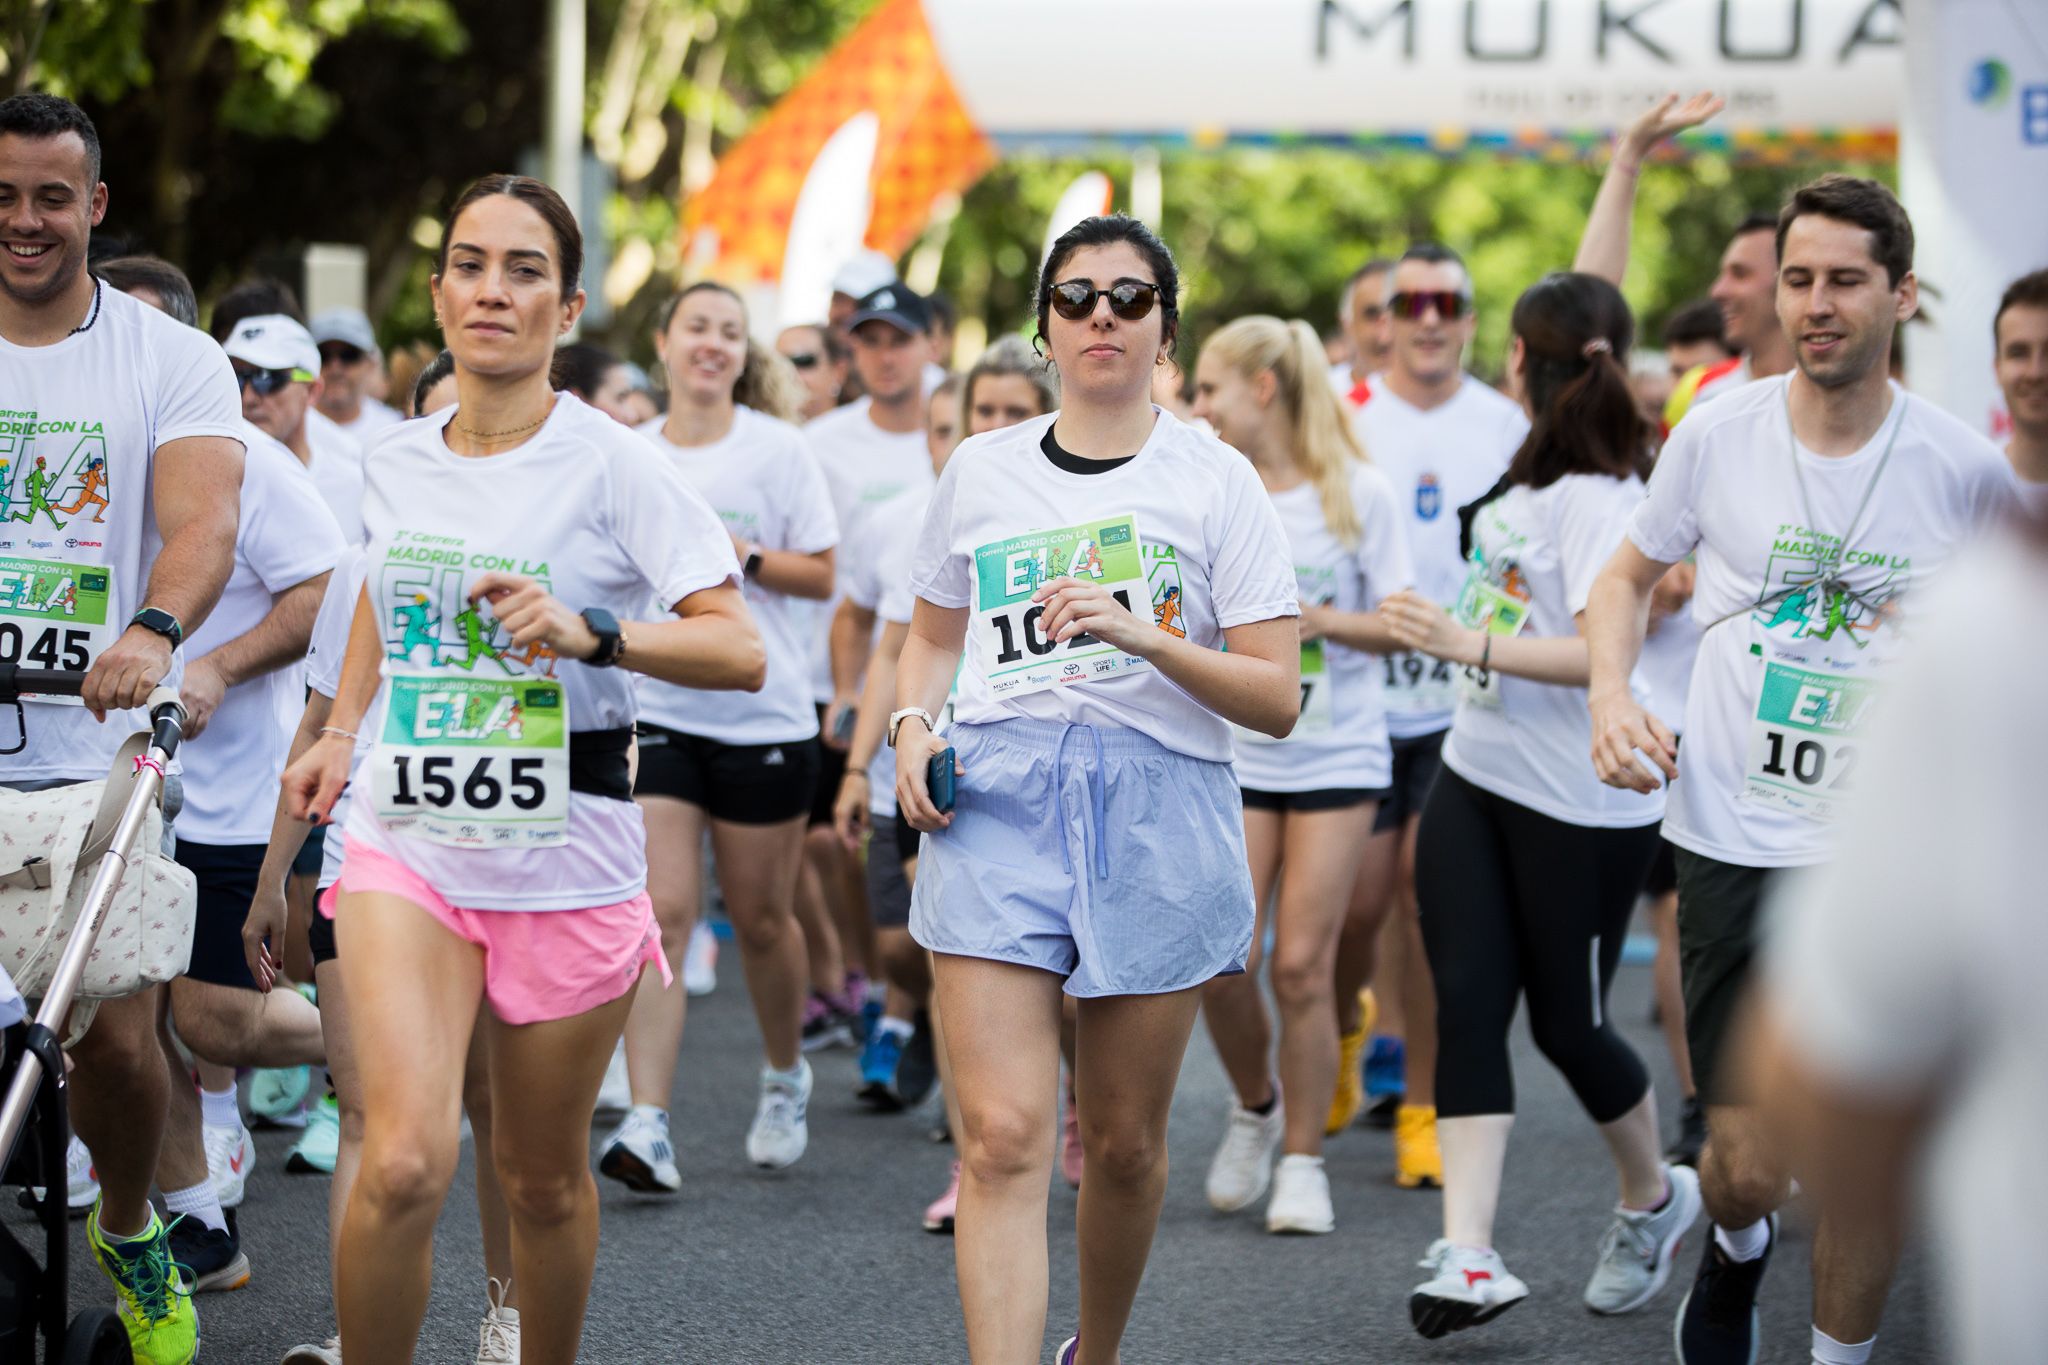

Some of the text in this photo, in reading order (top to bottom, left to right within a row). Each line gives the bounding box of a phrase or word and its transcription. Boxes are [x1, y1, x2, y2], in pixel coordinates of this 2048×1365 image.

[38, 422, 76, 433] CON
[80, 422, 104, 433] LA
[411, 532, 465, 546] Carrera
[1006, 537, 1048, 552] MADRID
[1051, 534, 1074, 544] CON
[1076, 528, 1089, 537] LA
[1153, 545, 1175, 559] LA
[0, 561, 73, 577] MADRID CON LA
[387, 546, 550, 577] MADRID CON LA
[1004, 538, 1104, 597] ELA
[1845, 551, 1886, 566] CON
[0, 570, 76, 616] ELA
[991, 589, 1132, 665] 10
[0, 622, 91, 672] 045
[993, 679, 1020, 690] MUKUA
[413, 692, 523, 740] ELA
[392, 755, 546, 810] 1565
